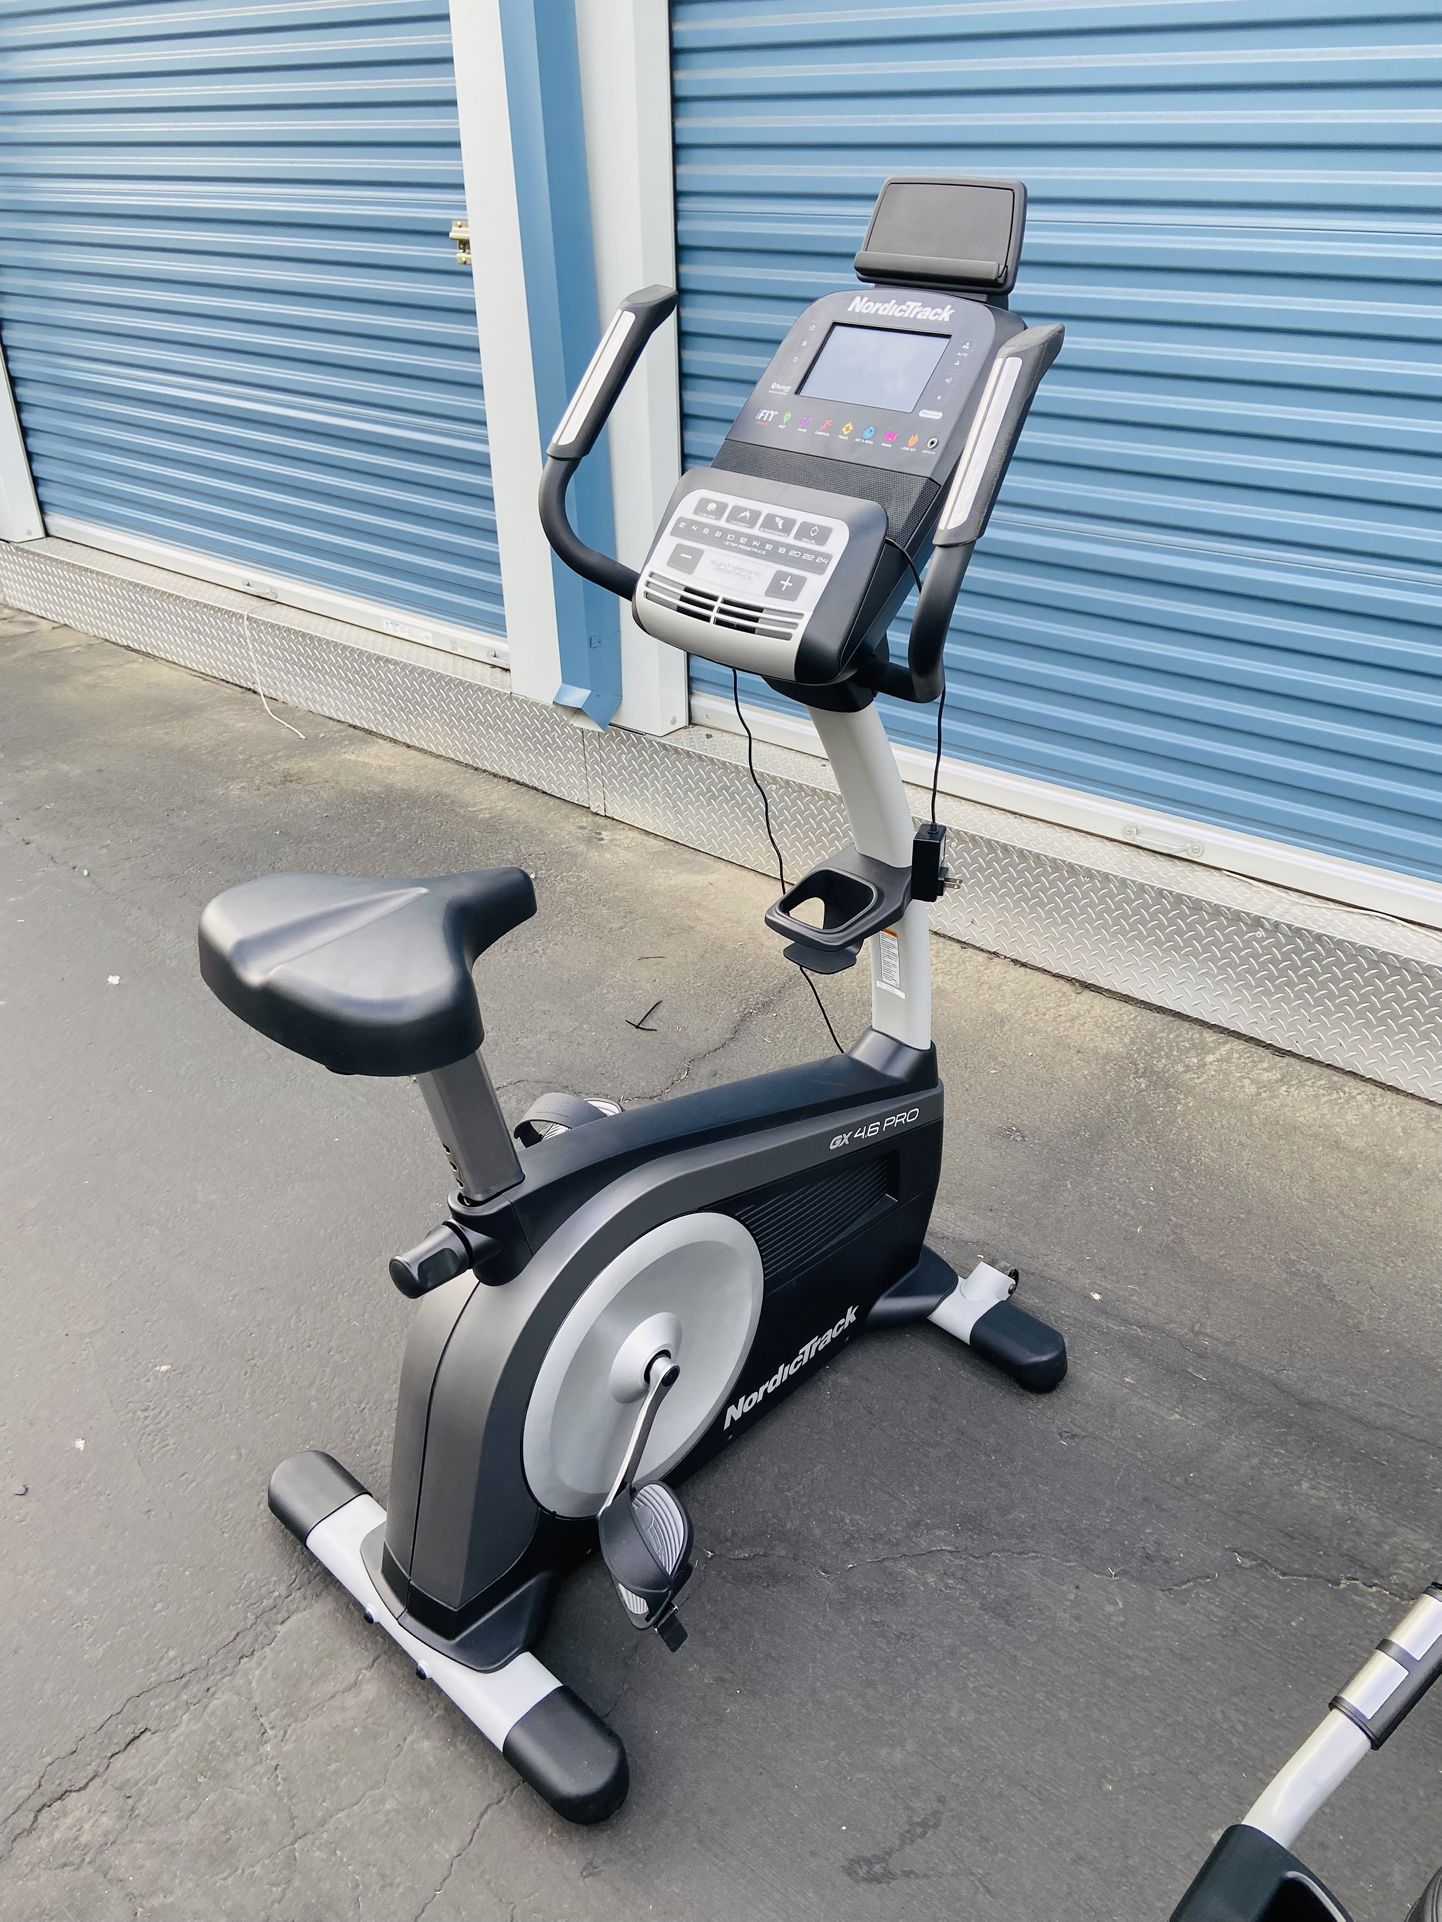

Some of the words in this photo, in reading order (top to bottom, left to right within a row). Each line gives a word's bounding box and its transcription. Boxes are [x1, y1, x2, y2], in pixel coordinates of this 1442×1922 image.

[847, 296, 955, 321] NordicTrack
[829, 1131, 854, 1151] GX
[853, 1121, 881, 1140] 4.6
[882, 1107, 920, 1132] PRO
[723, 1305, 860, 1431] NordicTrack
